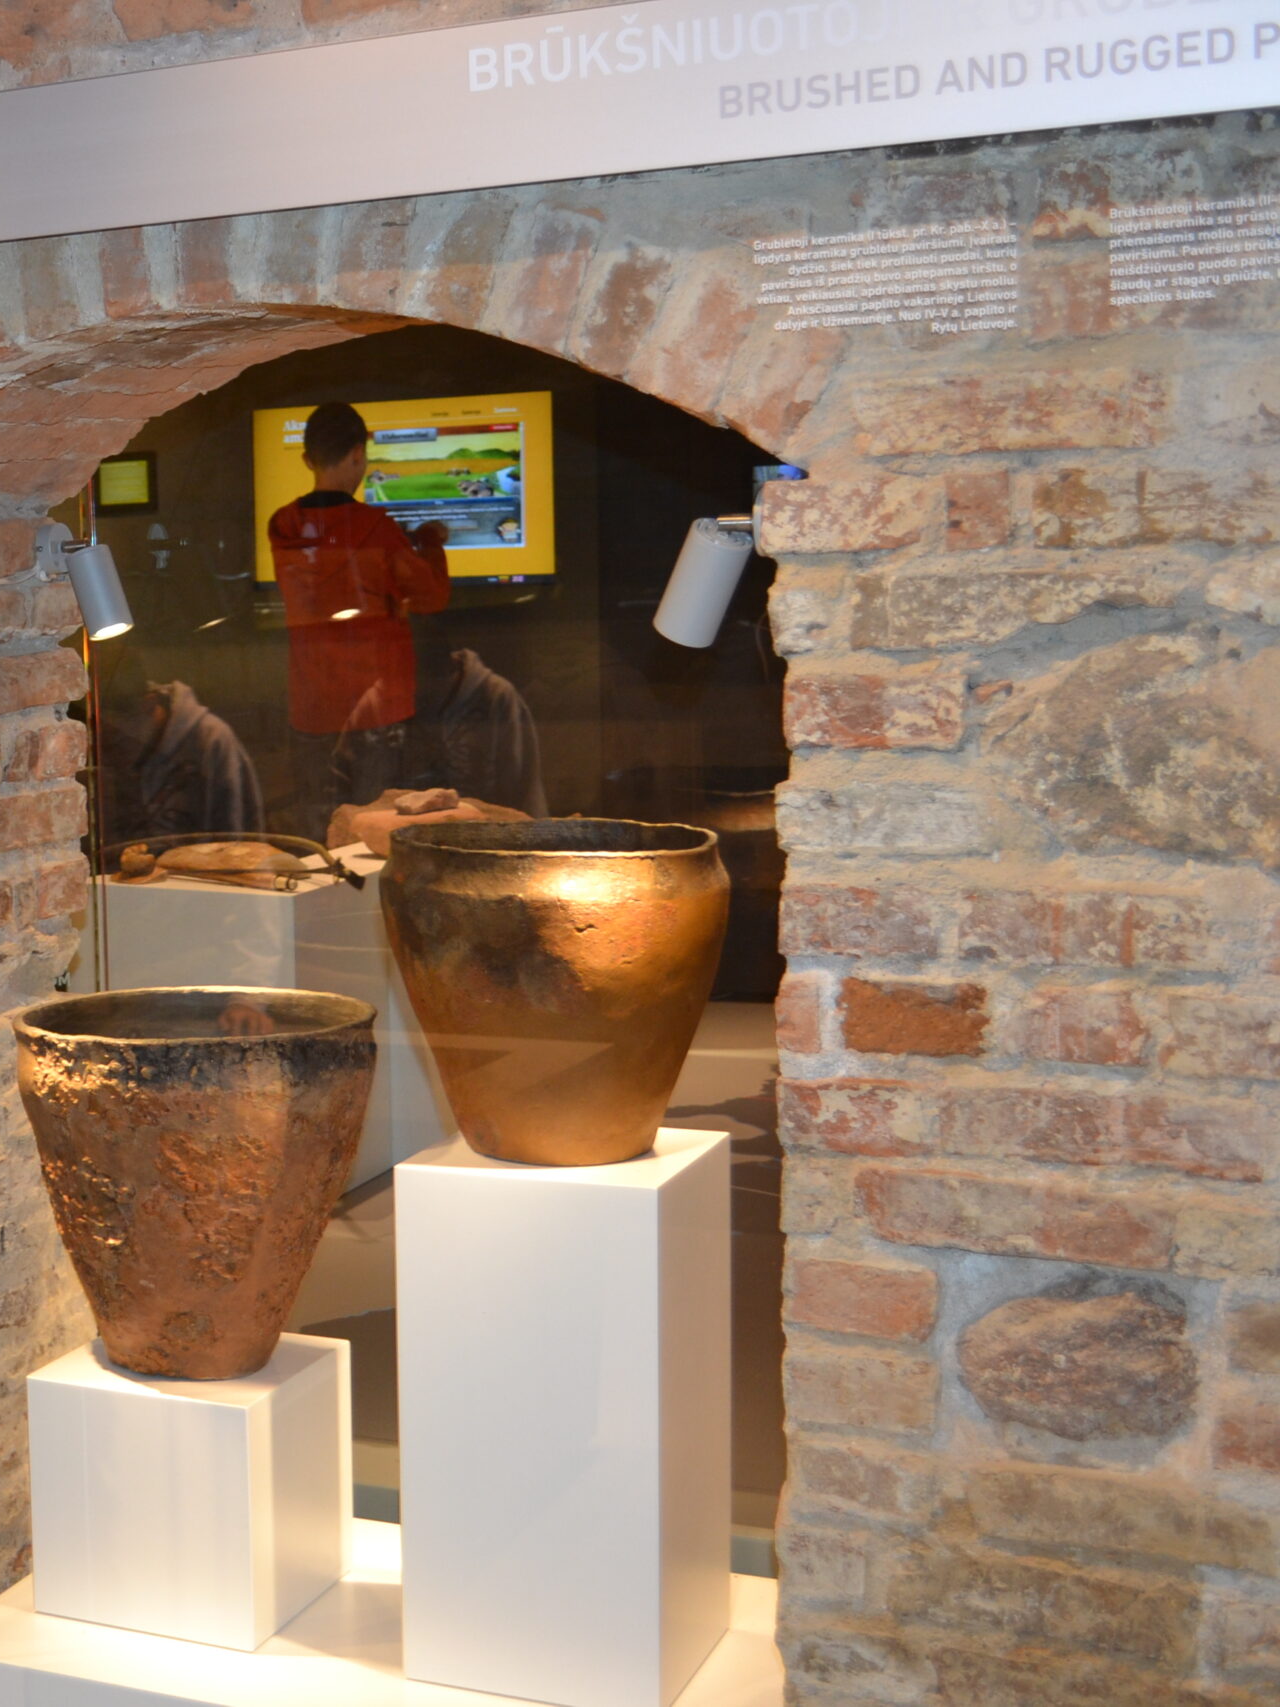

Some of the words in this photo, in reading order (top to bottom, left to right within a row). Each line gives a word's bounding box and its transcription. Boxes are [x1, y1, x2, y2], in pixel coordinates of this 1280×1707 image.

[720, 64, 920, 119] BRUSHED
[935, 52, 1027, 95] AND
[1045, 27, 1235, 82] RUGGED
